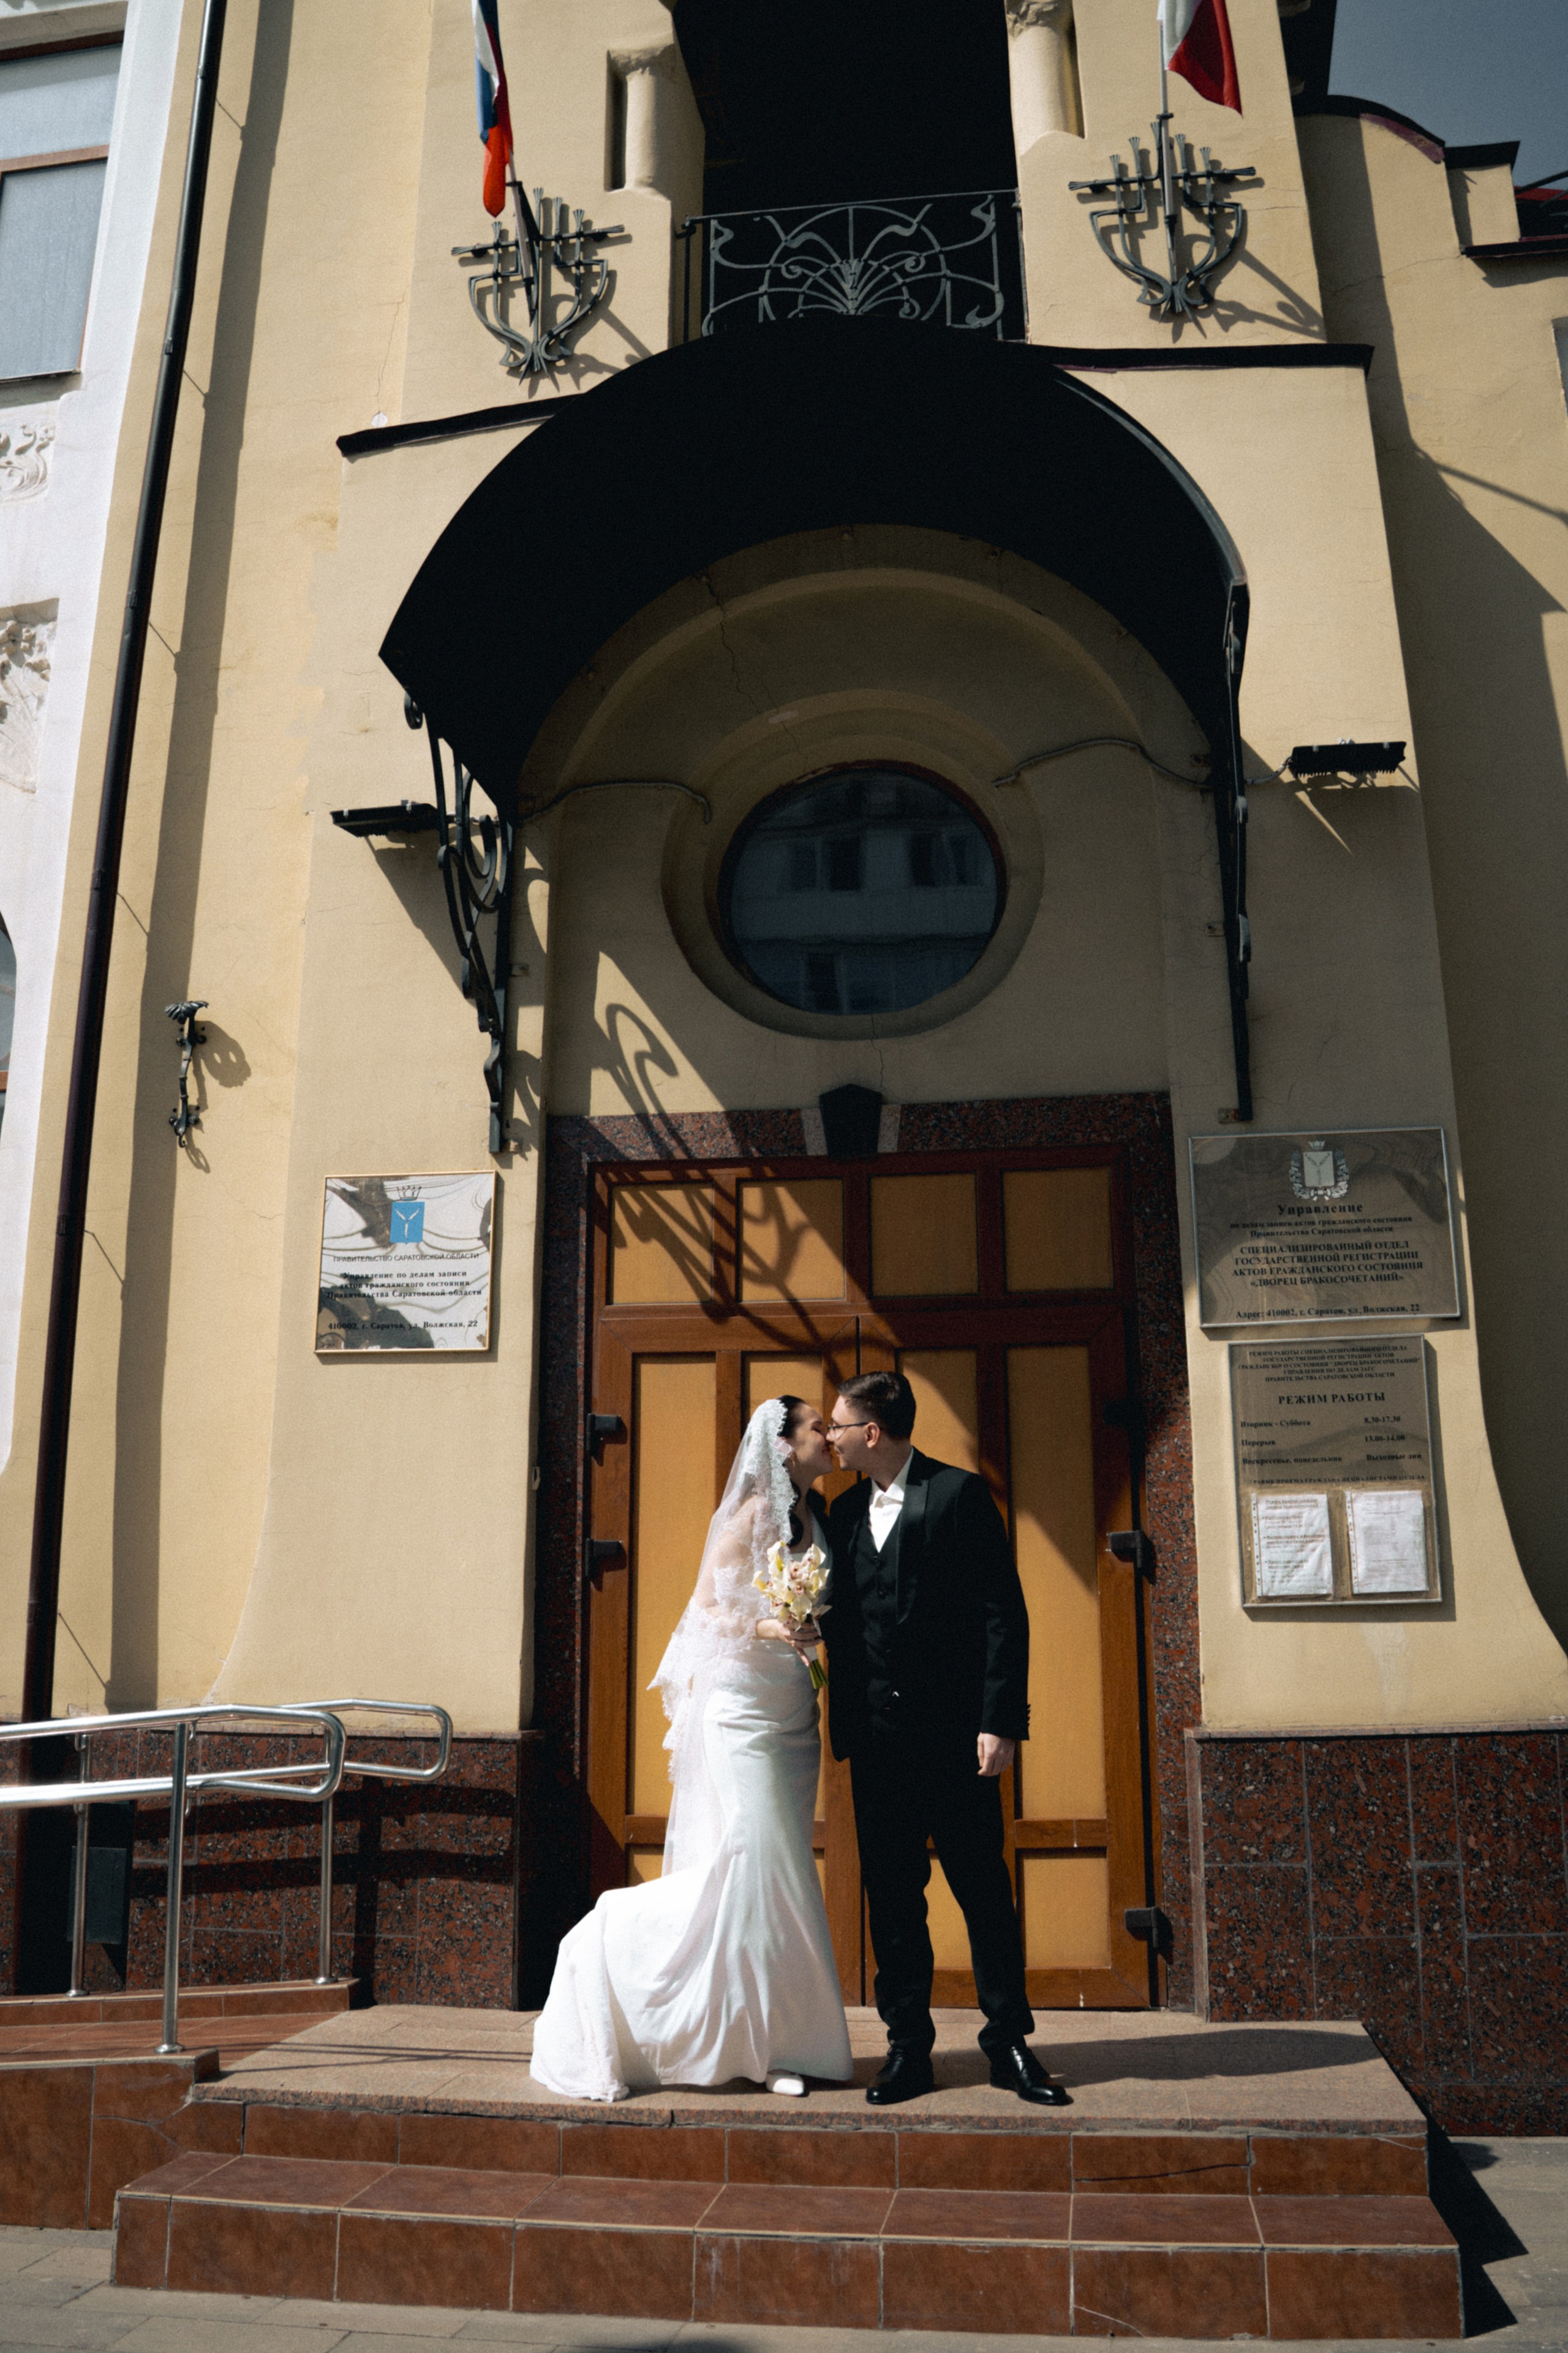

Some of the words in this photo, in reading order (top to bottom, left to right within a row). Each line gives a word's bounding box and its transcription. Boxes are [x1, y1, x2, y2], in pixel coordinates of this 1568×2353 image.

[1277, 1204, 1363, 1217] Управление
[1250, 1228, 1310, 1238] Правительства
[1311, 1226, 1361, 1236] Саратовской
[1240, 1241, 1372, 1255] СПЕЦИАЛИЗИРОВАННЫЙ
[1374, 1241, 1409, 1250] ОТДЕЛ
[1234, 1252, 1341, 1265] ГОСУДАРСТВЕННОЙ
[1343, 1250, 1419, 1261] РЕГИСТРАЦИИ
[1232, 1267, 1267, 1276] АКТОВ
[1270, 1264, 1355, 1275] ГРАЖДАНСКОГО
[1357, 1261, 1423, 1272] СОСТОЯНИЯ
[1250, 1277, 1298, 1287] «ДВОРЕЦ
[1300, 1272, 1404, 1285] БРАКОСОЧЕТАНИЙ»
[365, 1281, 424, 1290] гражданского
[326, 1291, 389, 1300] Правительства
[392, 1289, 445, 1299] Саратовской
[1236, 1310, 1264, 1320] Адрес:
[1278, 1394, 1328, 1405] РЕЖИМ
[1331, 1392, 1385, 1403] РАБОТЫ
[1279, 1419, 1311, 1428] Суббота
[1364, 1416, 1401, 1424] 8.30-17.30
[1365, 1434, 1406, 1443] 13.00-14.00
[1366, 1453, 1406, 1462] Выходные
